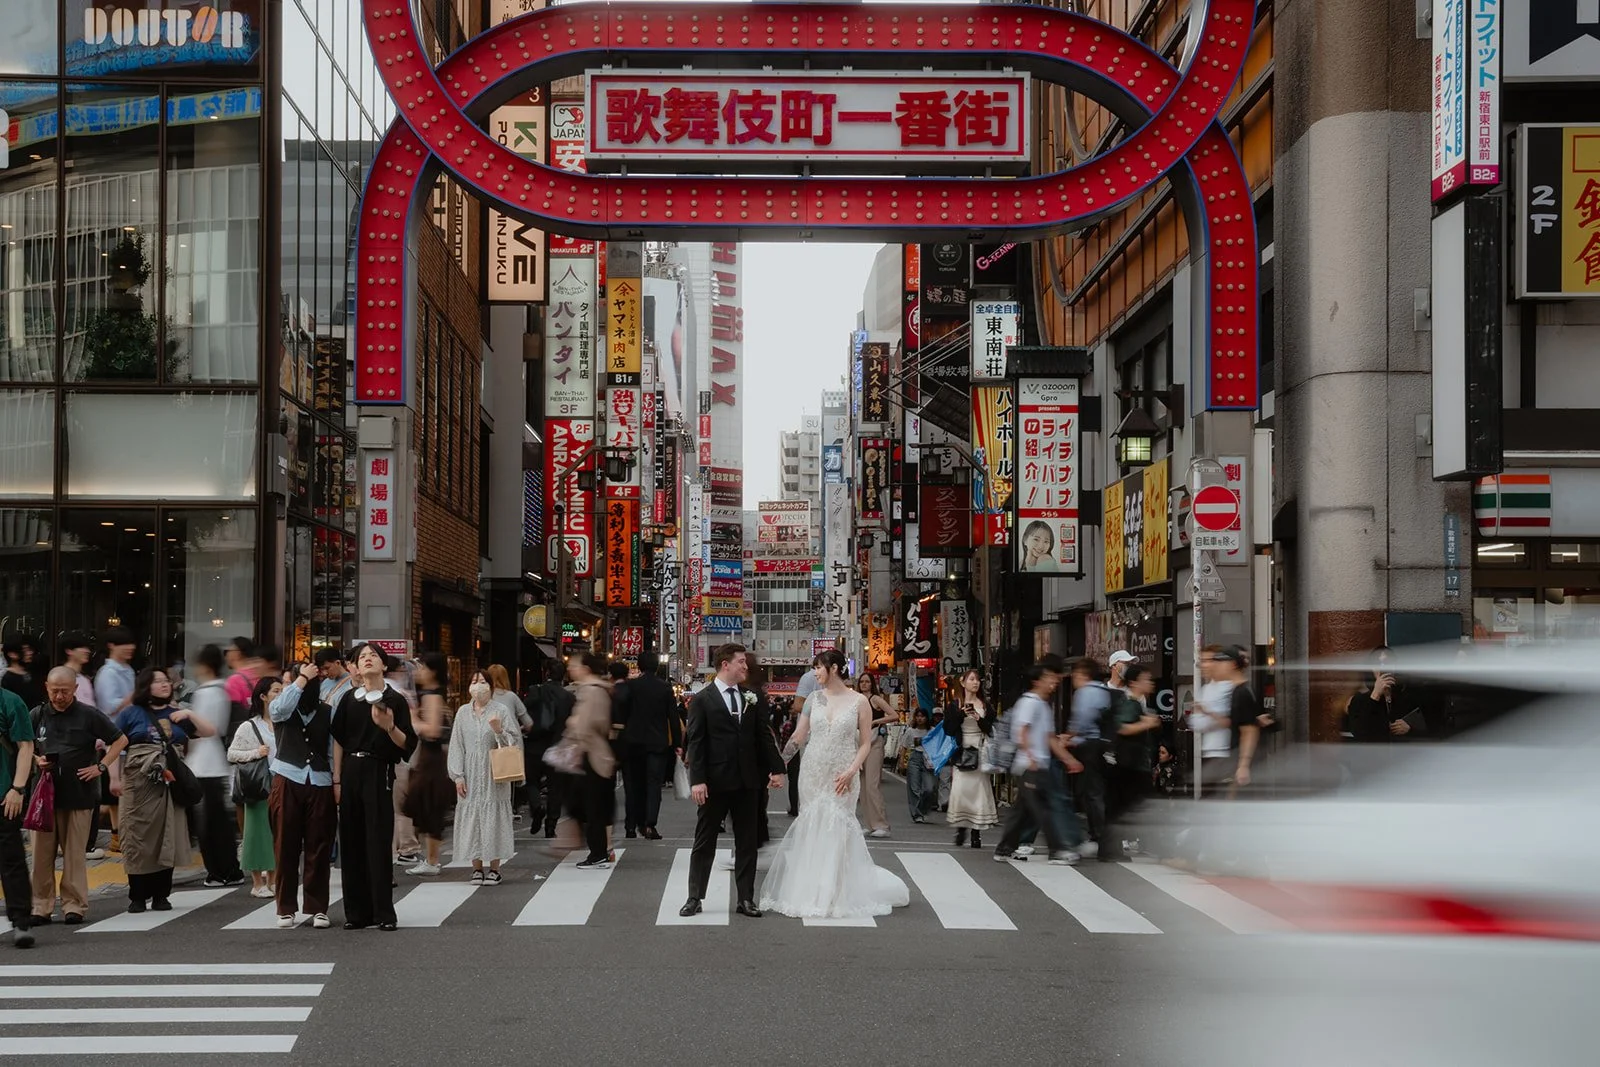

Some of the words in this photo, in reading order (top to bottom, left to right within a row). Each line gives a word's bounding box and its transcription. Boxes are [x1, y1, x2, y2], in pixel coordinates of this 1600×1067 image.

[85, 6, 244, 48] DOUTOR
[606, 88, 1009, 146] 歌舞伎町一番街
[1480, 91, 1491, 160] 新宿東口駅前
[1474, 167, 1495, 180] B2F
[580, 244, 593, 253] 2F
[552, 300, 577, 385] バンタイ
[580, 302, 590, 379] タイ国料理専門店
[613, 299, 627, 369] ヤマネ肉店
[985, 317, 1002, 377] 東南荘
[615, 373, 633, 383] B1F
[560, 405, 577, 414] 3F
[574, 424, 591, 435] 2F
[996, 391, 1012, 476] ハイボール
[371, 458, 396, 550] 劇場通り
[615, 488, 632, 496] 4F
[1195, 534, 1236, 547] 自転車を除く
[1448, 576, 1458, 584] 17
[708, 617, 741, 628] SAUNA
